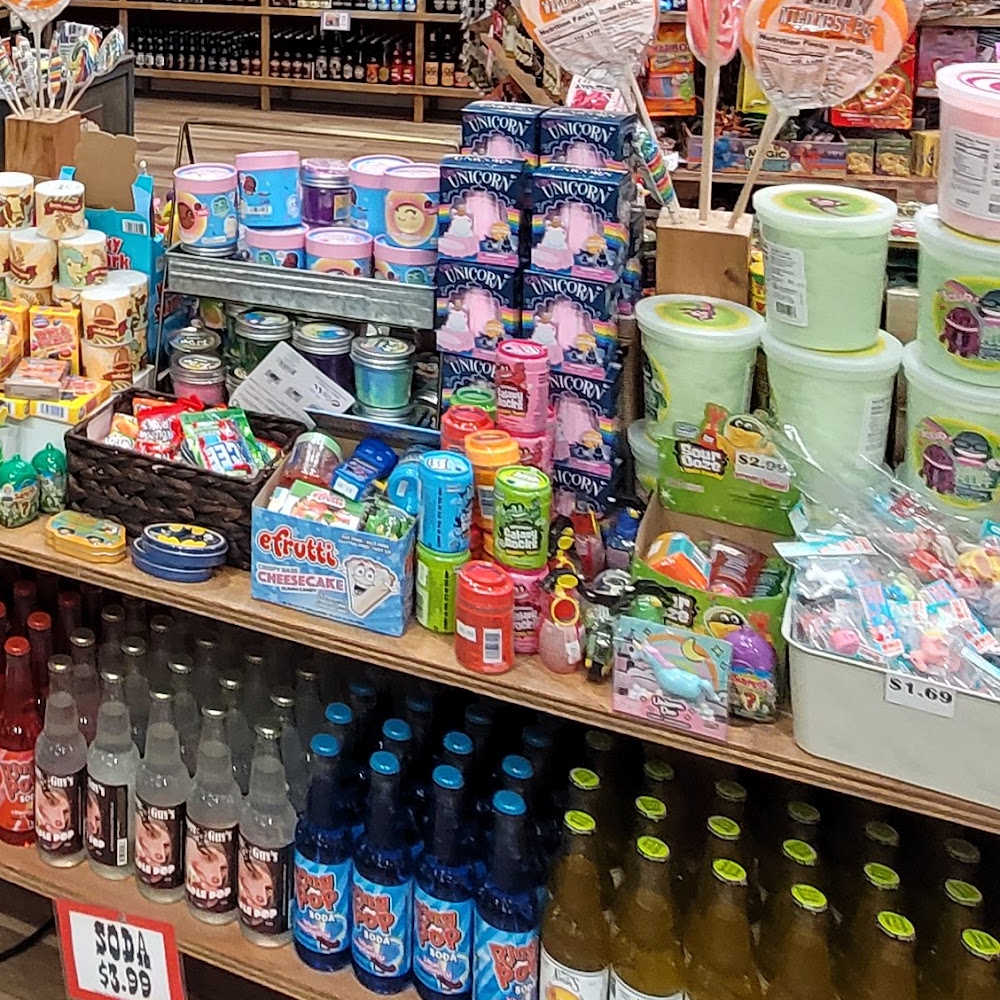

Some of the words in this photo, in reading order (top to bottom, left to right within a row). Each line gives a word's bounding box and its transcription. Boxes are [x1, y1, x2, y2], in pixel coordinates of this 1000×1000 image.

[759, 33, 802, 47] Nutrition
[467, 115, 529, 138] UNICORN
[547, 121, 613, 145] UNICORN
[747, 146, 789, 160] MGIC
[447, 169, 514, 193] UNICORN
[541, 180, 611, 205] UNICORN
[444, 266, 507, 291] UNICORN
[531, 278, 600, 304] UNICORN
[549, 375, 606, 401] NICORN
[679, 442, 723, 461] Sour
[680, 454, 722, 473] Ooze
[737, 454, 789, 474] $2.99
[257, 526, 339, 570] efrutti
[256, 571, 345, 592] CHEESECAKE
[888, 677, 953, 704] $1.69
[53, 830, 75, 842] POP
[152, 864, 176, 876] POP
[208, 887, 232, 899] POP
[253, 908, 278, 920] POP
[309, 911, 335, 922] SODA
[94, 920, 152, 970] SODA
[363, 931, 390, 945] SODA
[429, 948, 457, 962] SODA
[98, 960, 151, 998] $3.99
